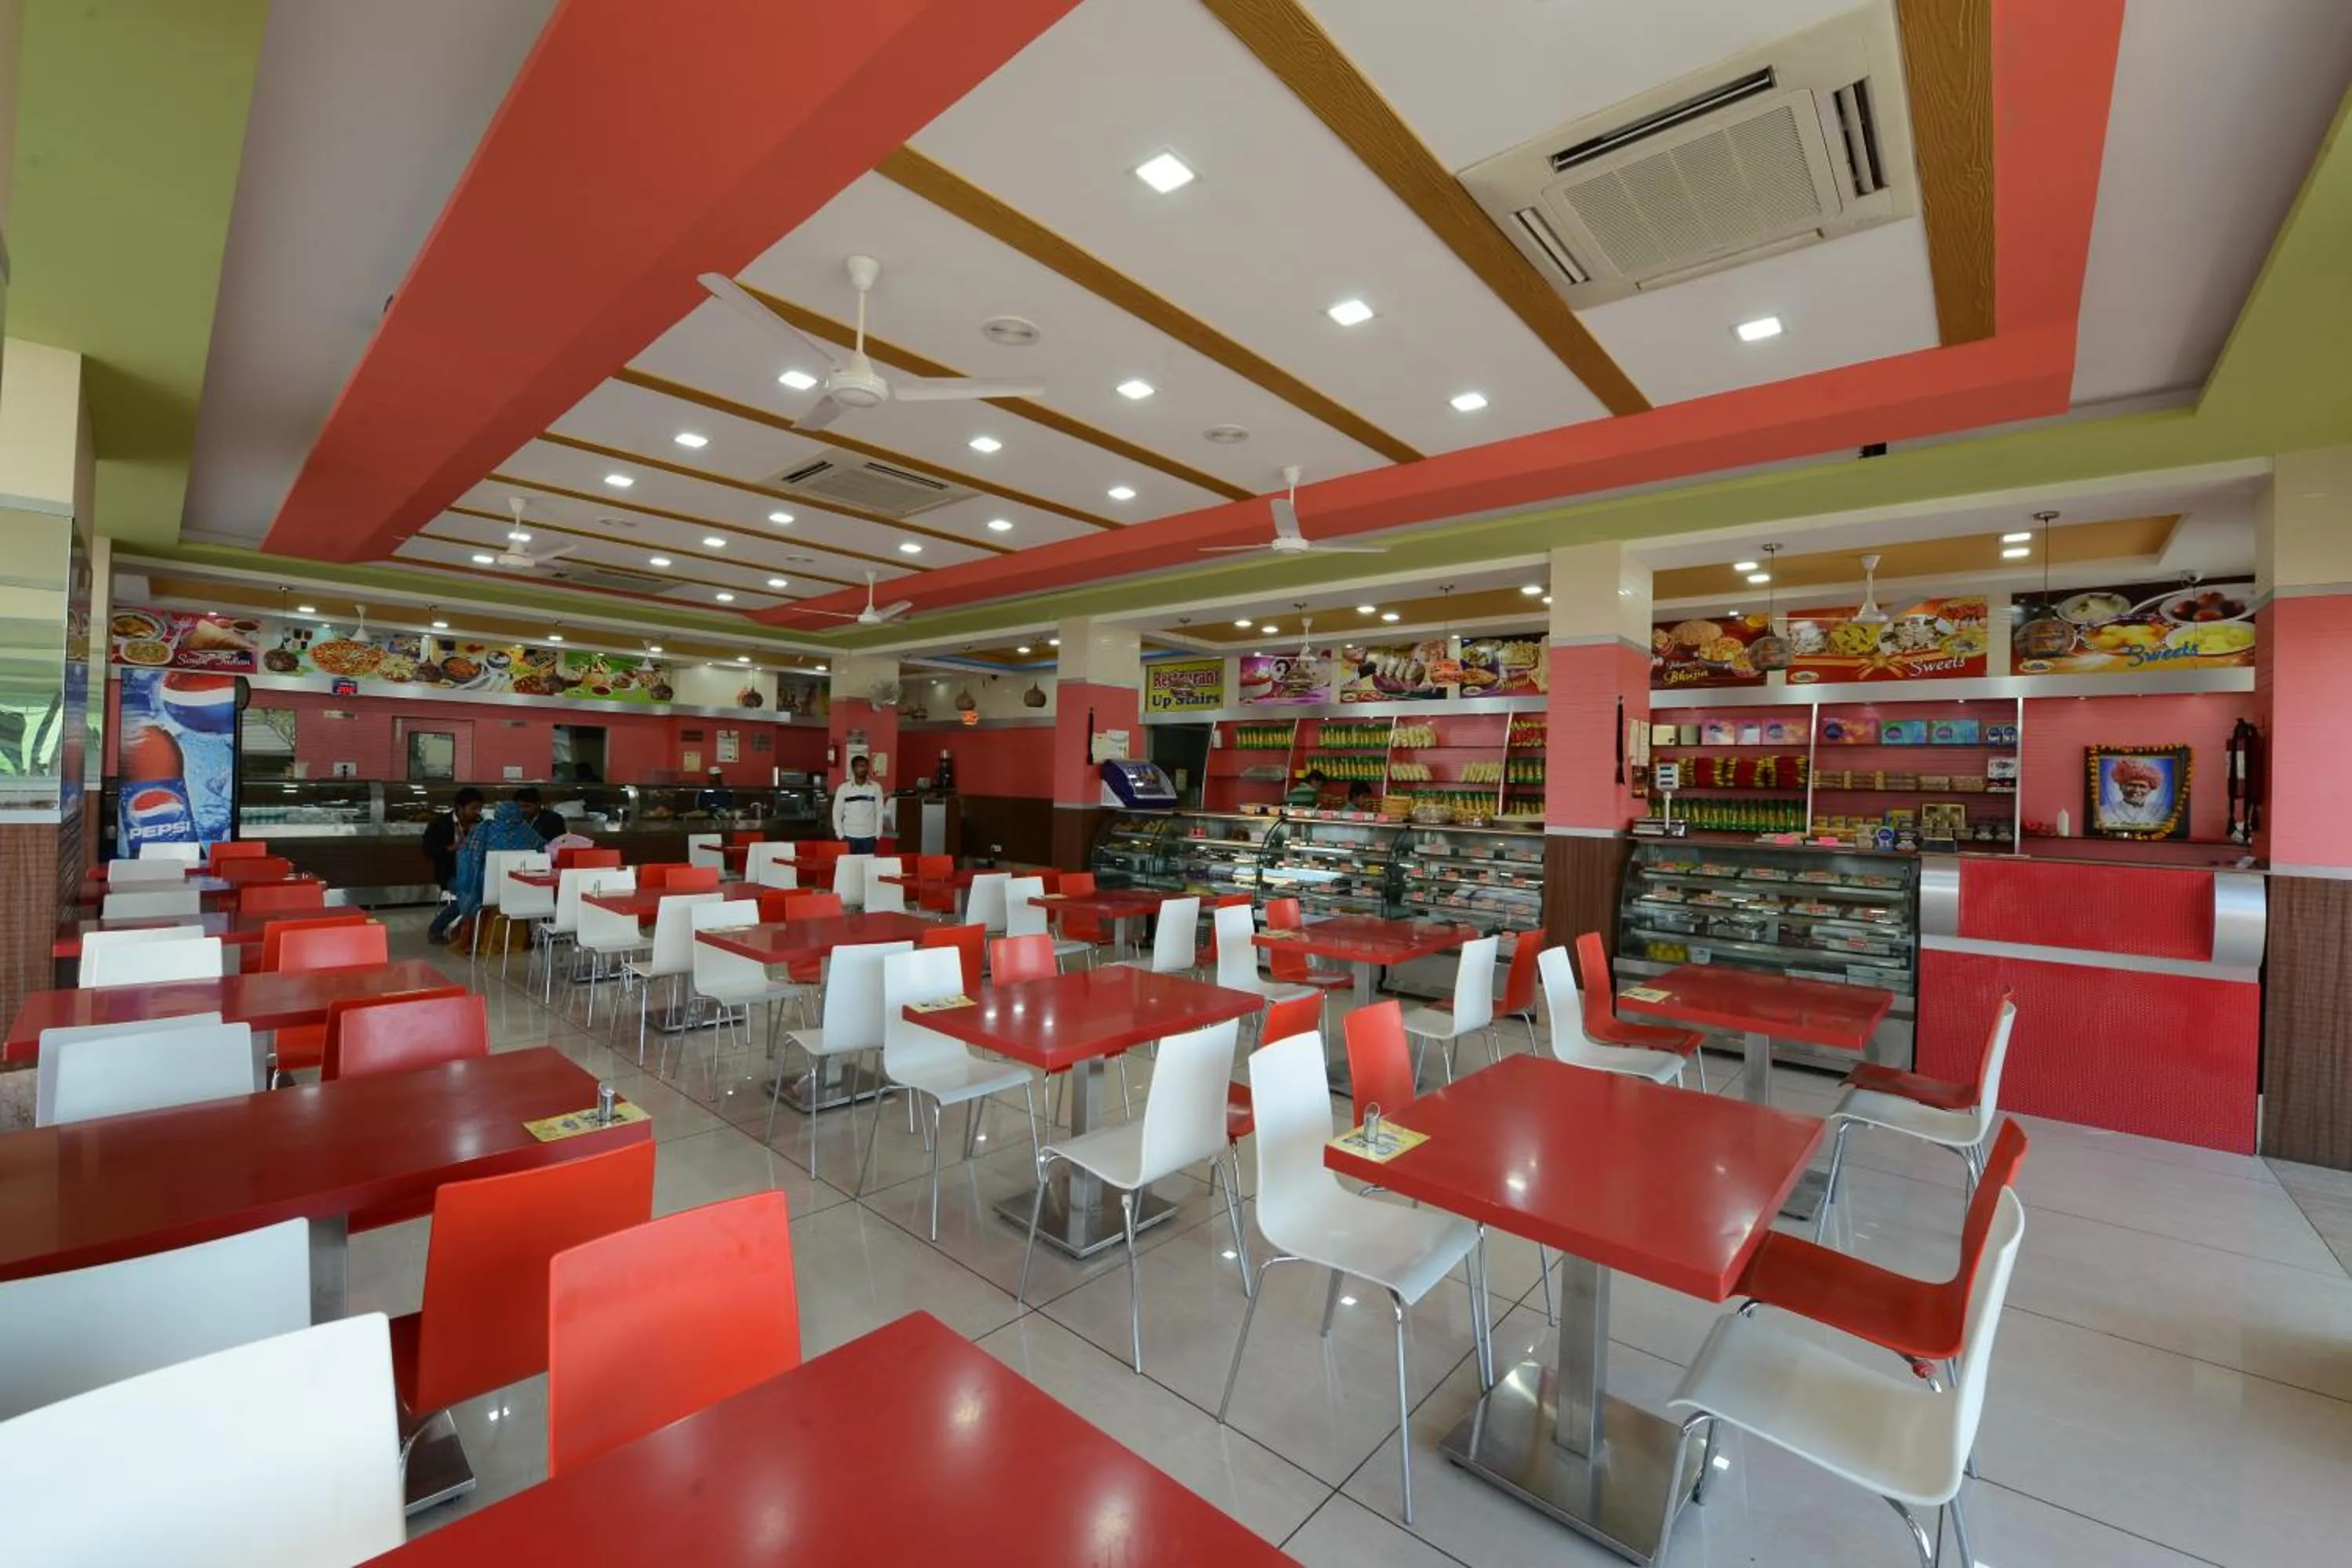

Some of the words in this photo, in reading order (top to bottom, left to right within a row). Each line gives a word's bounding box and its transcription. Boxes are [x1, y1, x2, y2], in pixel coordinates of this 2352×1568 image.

[2125, 641, 2198, 667] Sweets
[1909, 655, 1965, 677] Sweets
[1152, 695, 1171, 709] Up
[1176, 691, 1221, 705] Stairs
[129, 821, 191, 840] PEPSI
